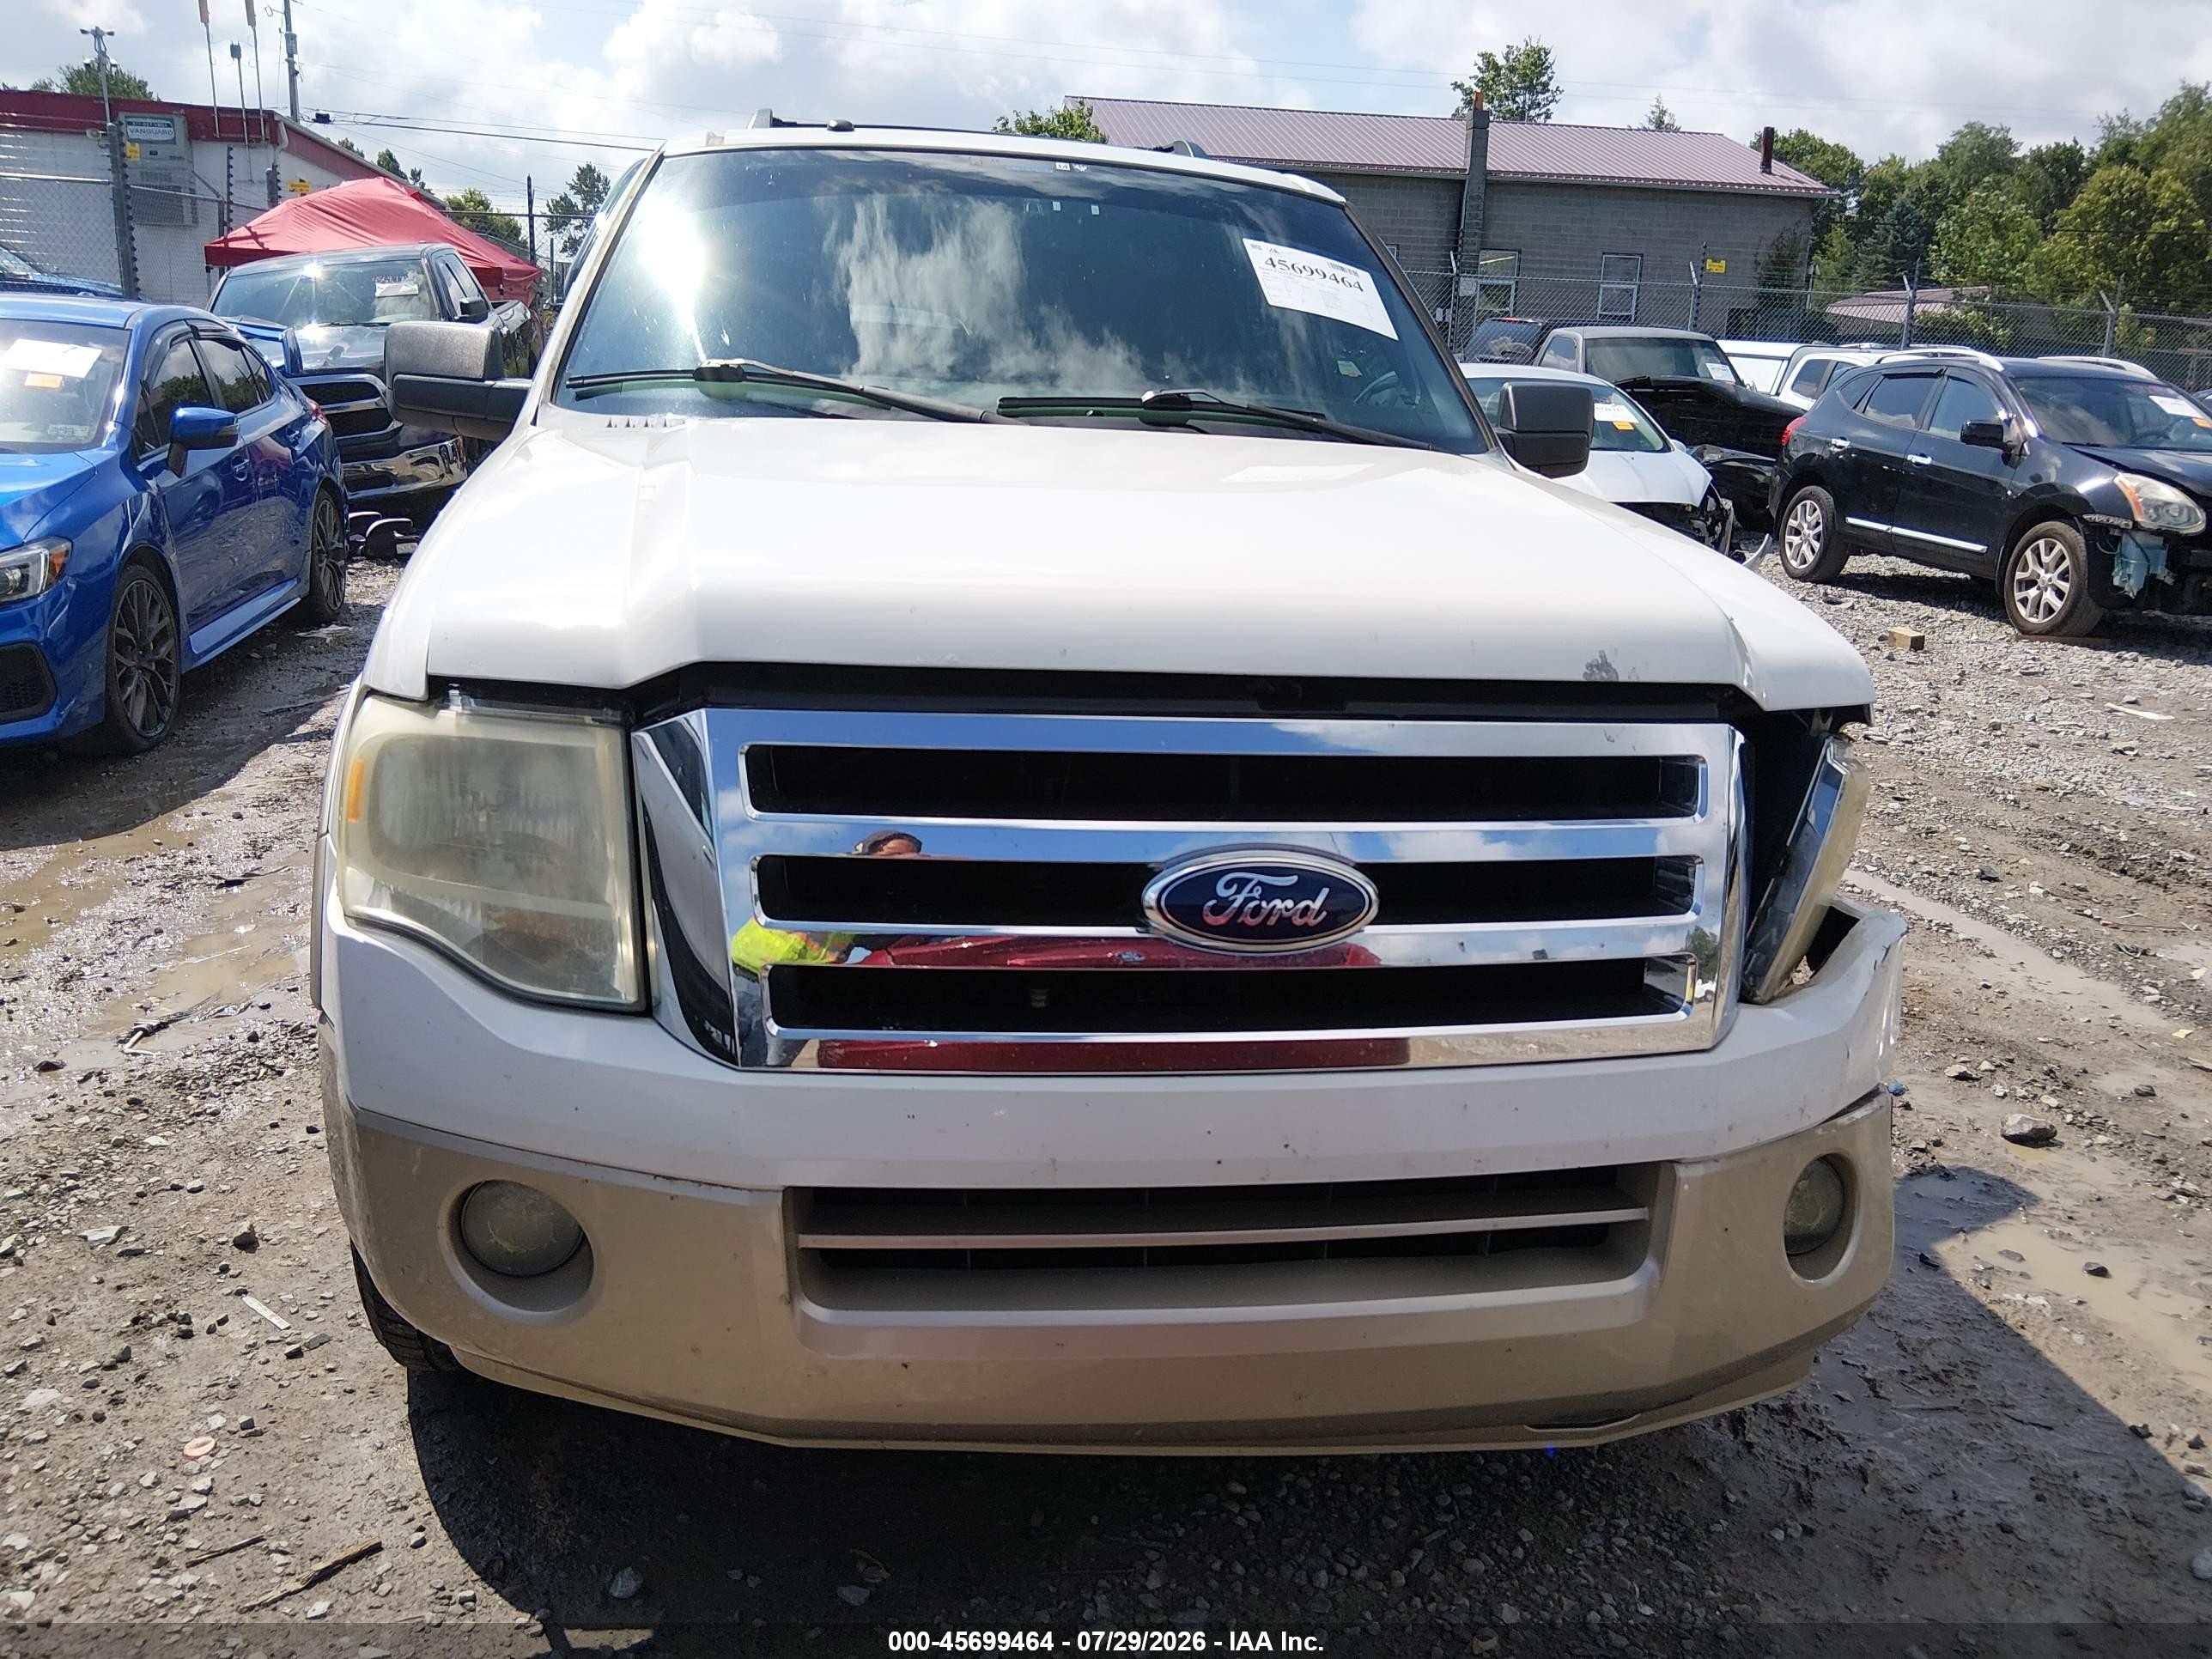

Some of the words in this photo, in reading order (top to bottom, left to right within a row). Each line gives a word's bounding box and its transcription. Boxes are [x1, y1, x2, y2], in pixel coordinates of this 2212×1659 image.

[129, 127, 173, 136] VANGUARD
[1265, 257, 1364, 292] 45699464
[1201, 872, 1331, 927] Ford
